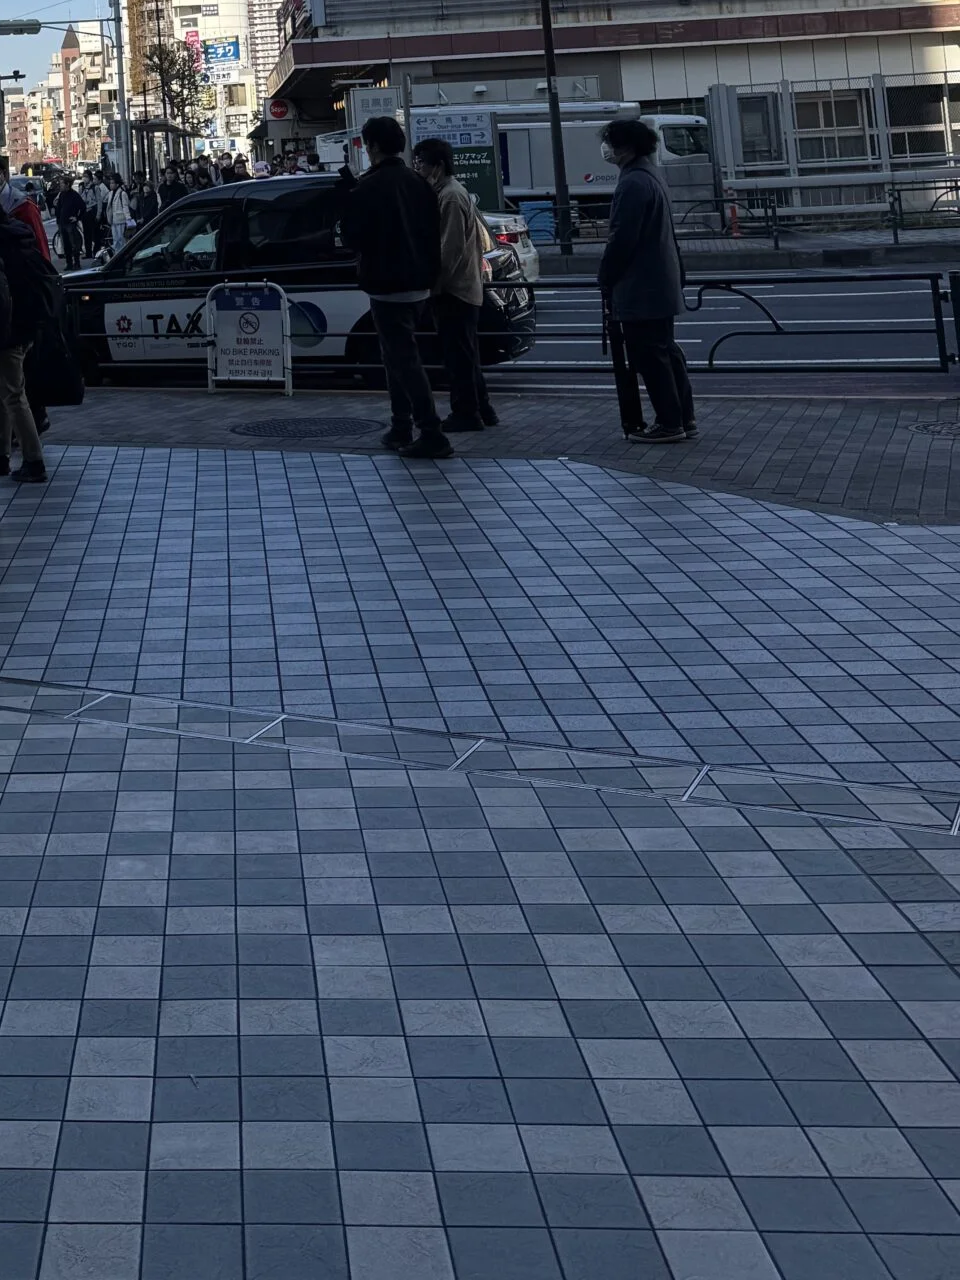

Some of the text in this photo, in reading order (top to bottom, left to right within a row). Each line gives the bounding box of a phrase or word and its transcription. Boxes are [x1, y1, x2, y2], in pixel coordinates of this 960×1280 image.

[146, 313, 204, 340] TAX
[220, 347, 280, 357] NO BIKE PARKING
